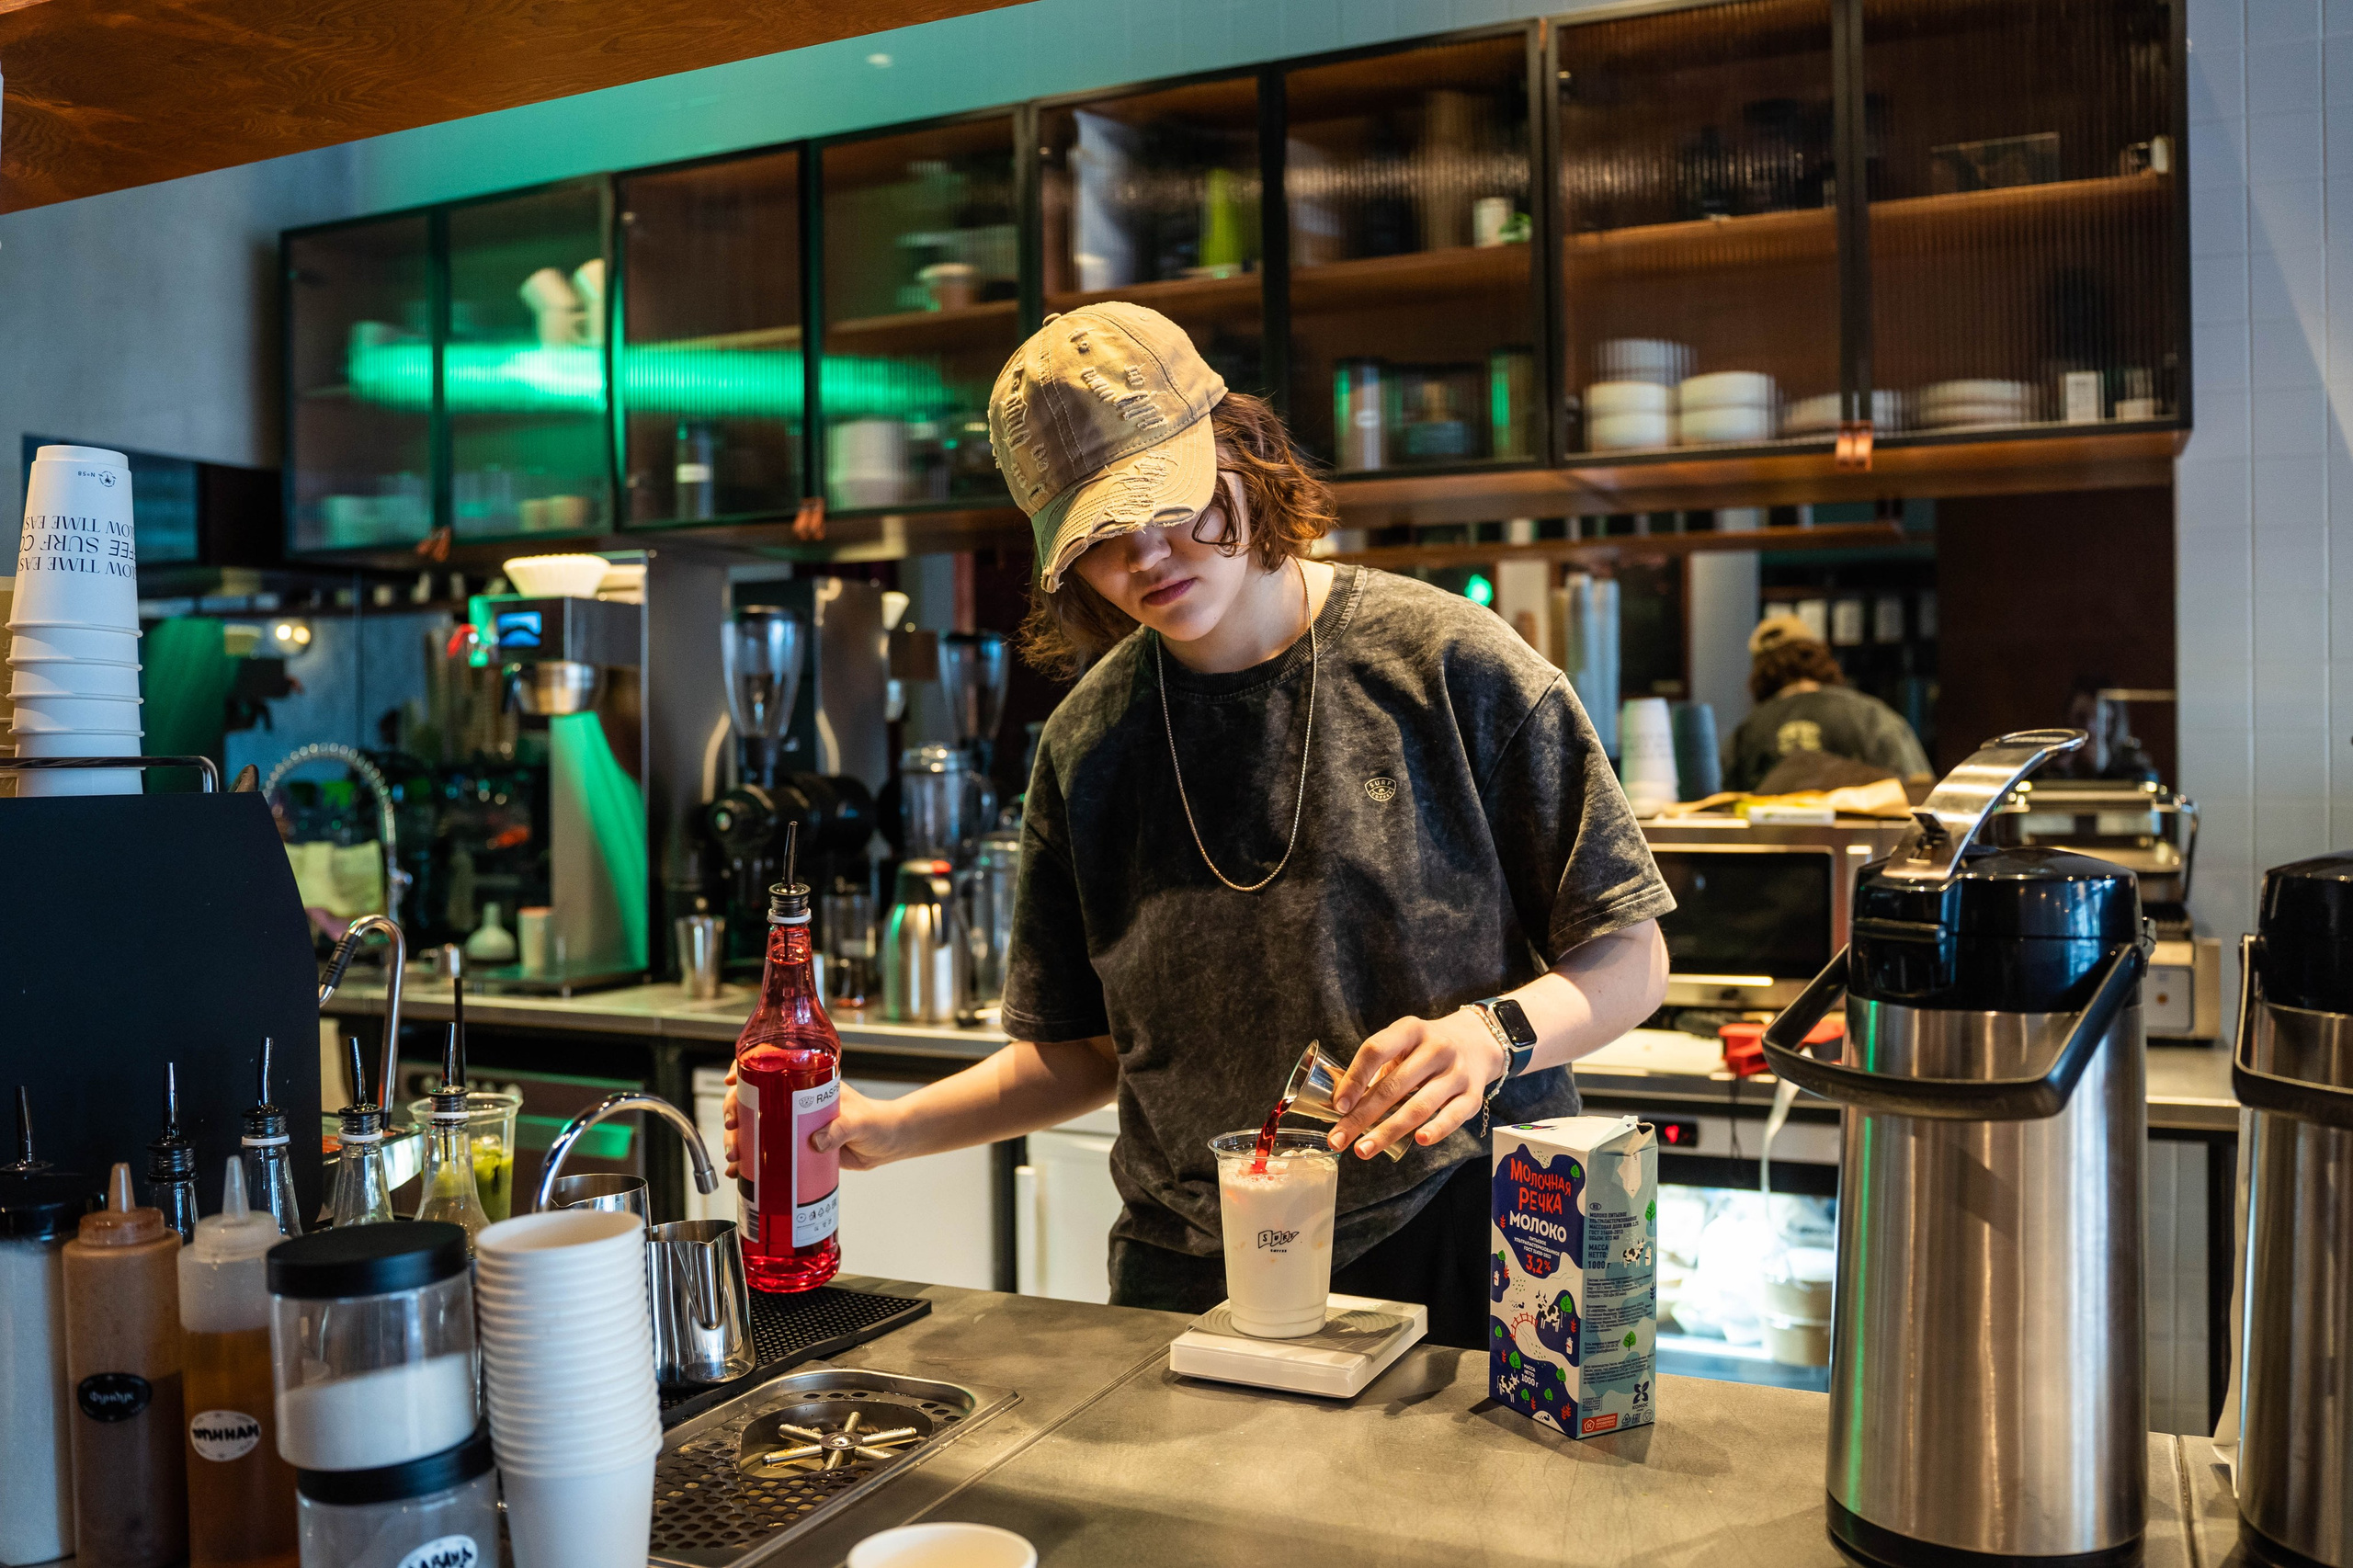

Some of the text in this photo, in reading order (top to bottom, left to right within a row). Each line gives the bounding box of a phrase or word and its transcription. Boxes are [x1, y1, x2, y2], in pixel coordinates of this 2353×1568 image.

[23, 516, 135, 539] LOW TIME EAS
[40, 534, 99, 553] SURF
[18, 557, 137, 580] LOW TIME EAS
[1518, 1187, 1563, 1215] РЕЧКА
[1509, 1210, 1567, 1243] МОЛОКО
[1588, 1261, 1606, 1269] 1000
[1521, 1373, 1535, 1386] 1000
